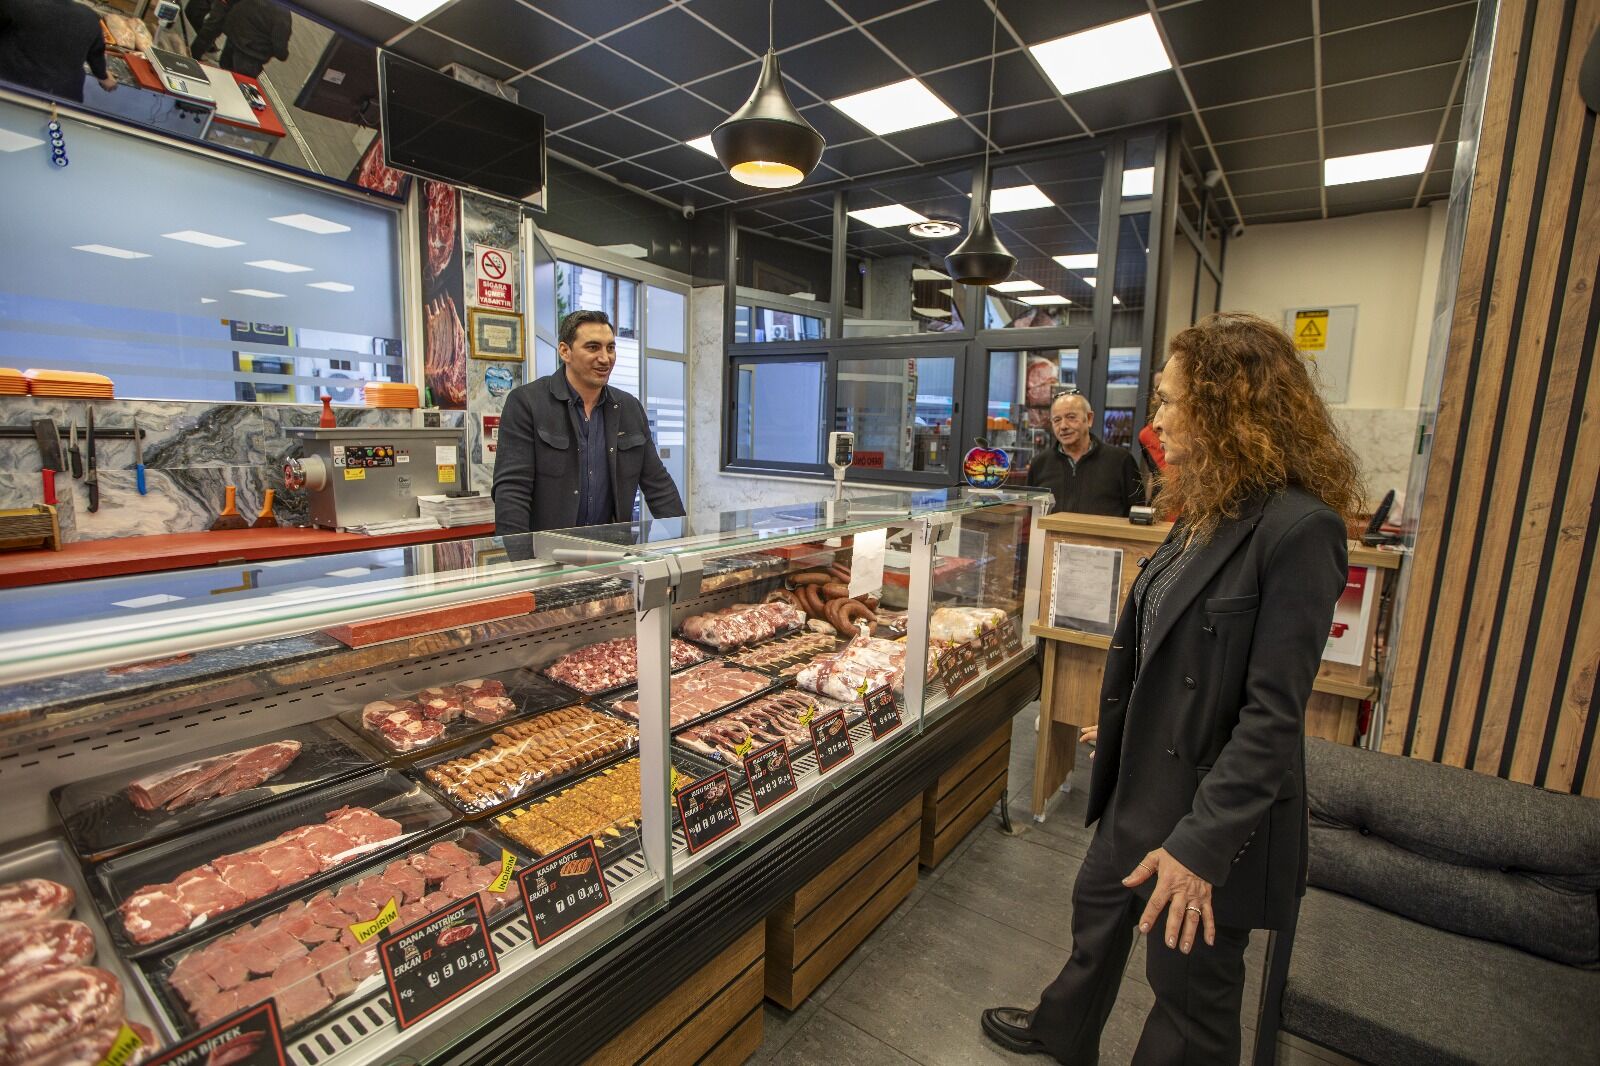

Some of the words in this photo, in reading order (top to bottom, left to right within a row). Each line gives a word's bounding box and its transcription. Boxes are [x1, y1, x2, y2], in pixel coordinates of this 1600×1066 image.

[536, 862, 558, 878] KASAP
[529, 885, 549, 902] ERKAN
[358, 911, 397, 941] İNDİRİM
[399, 930, 426, 949] DANA
[426, 908, 466, 935] ANTRİKOT
[393, 955, 422, 977] ERKAN
[423, 948, 433, 962] ET
[198, 1026, 241, 1056] BİFTEK
